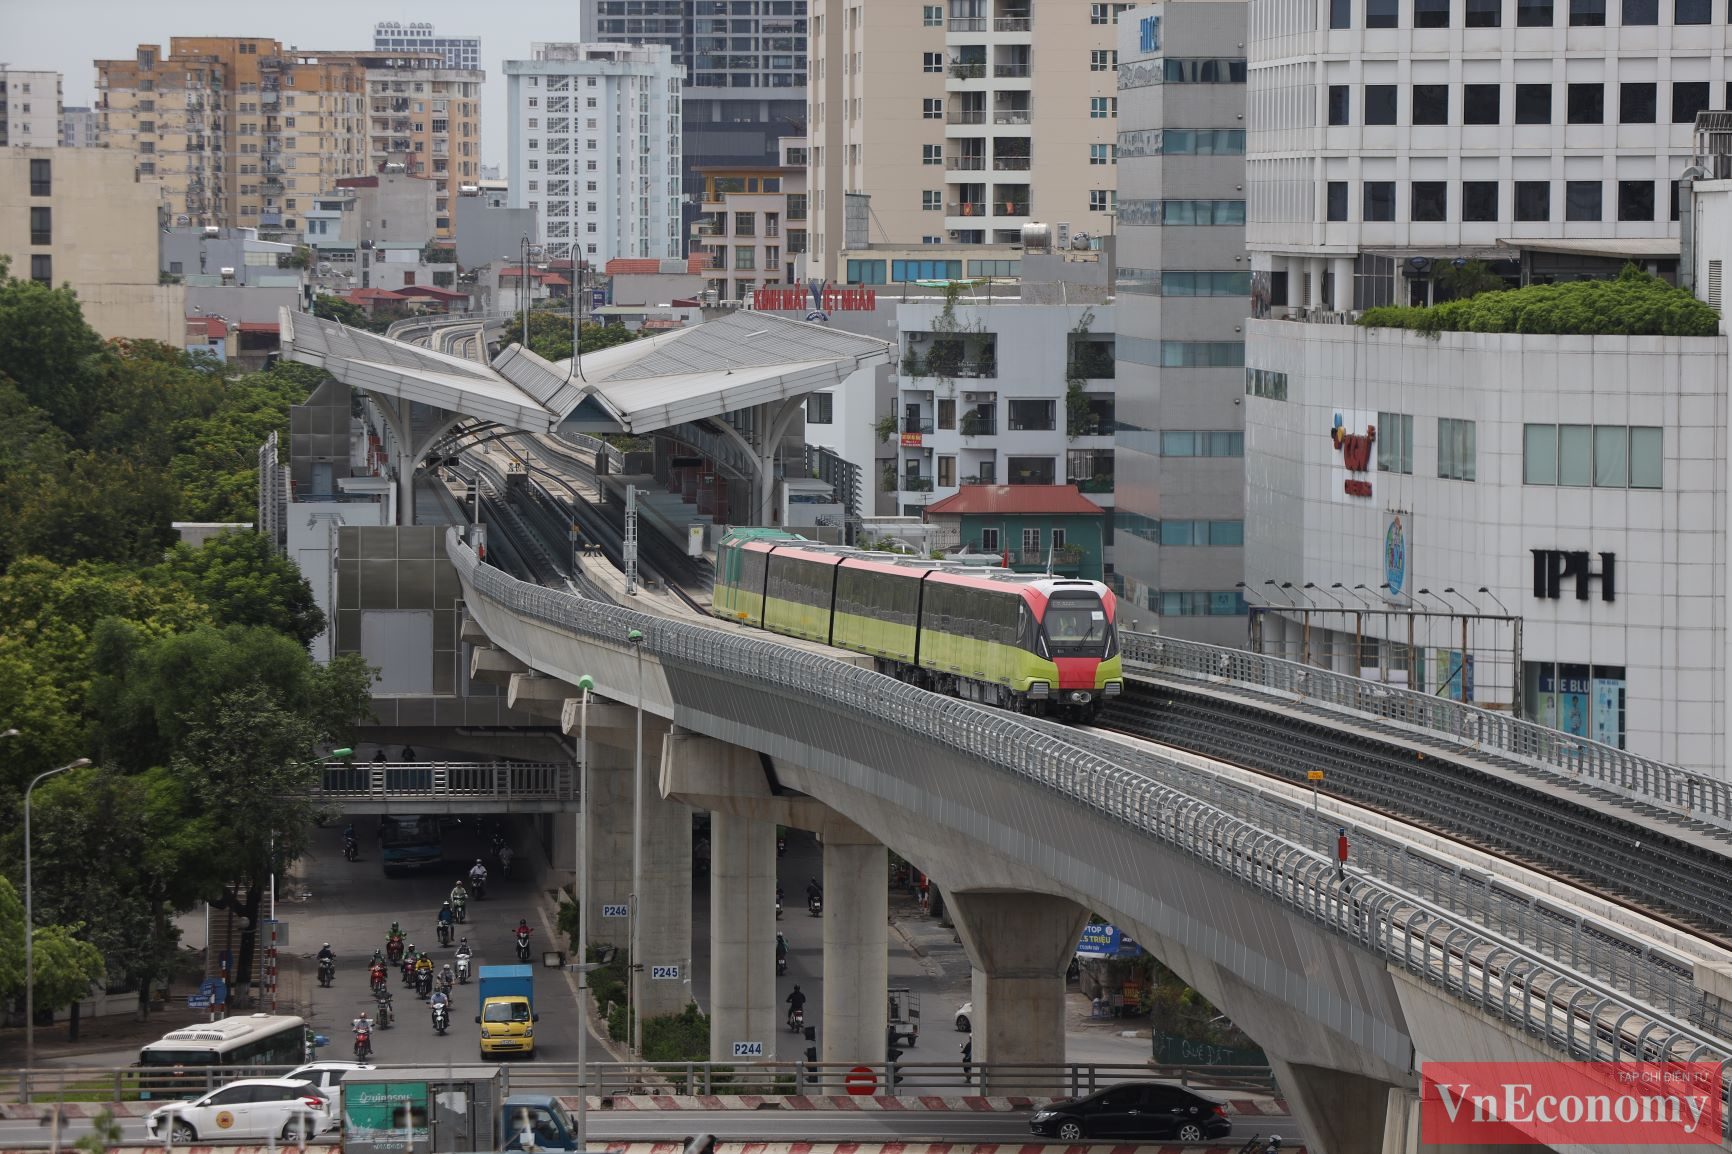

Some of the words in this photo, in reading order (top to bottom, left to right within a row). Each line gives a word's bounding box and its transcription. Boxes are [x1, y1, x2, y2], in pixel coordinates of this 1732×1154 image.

[754, 282, 780, 310] KÍNH
[1529, 550, 1616, 602] IPH
[604, 906, 627, 916] P246
[653, 968, 678, 977] P245
[735, 1043, 762, 1054] P244
